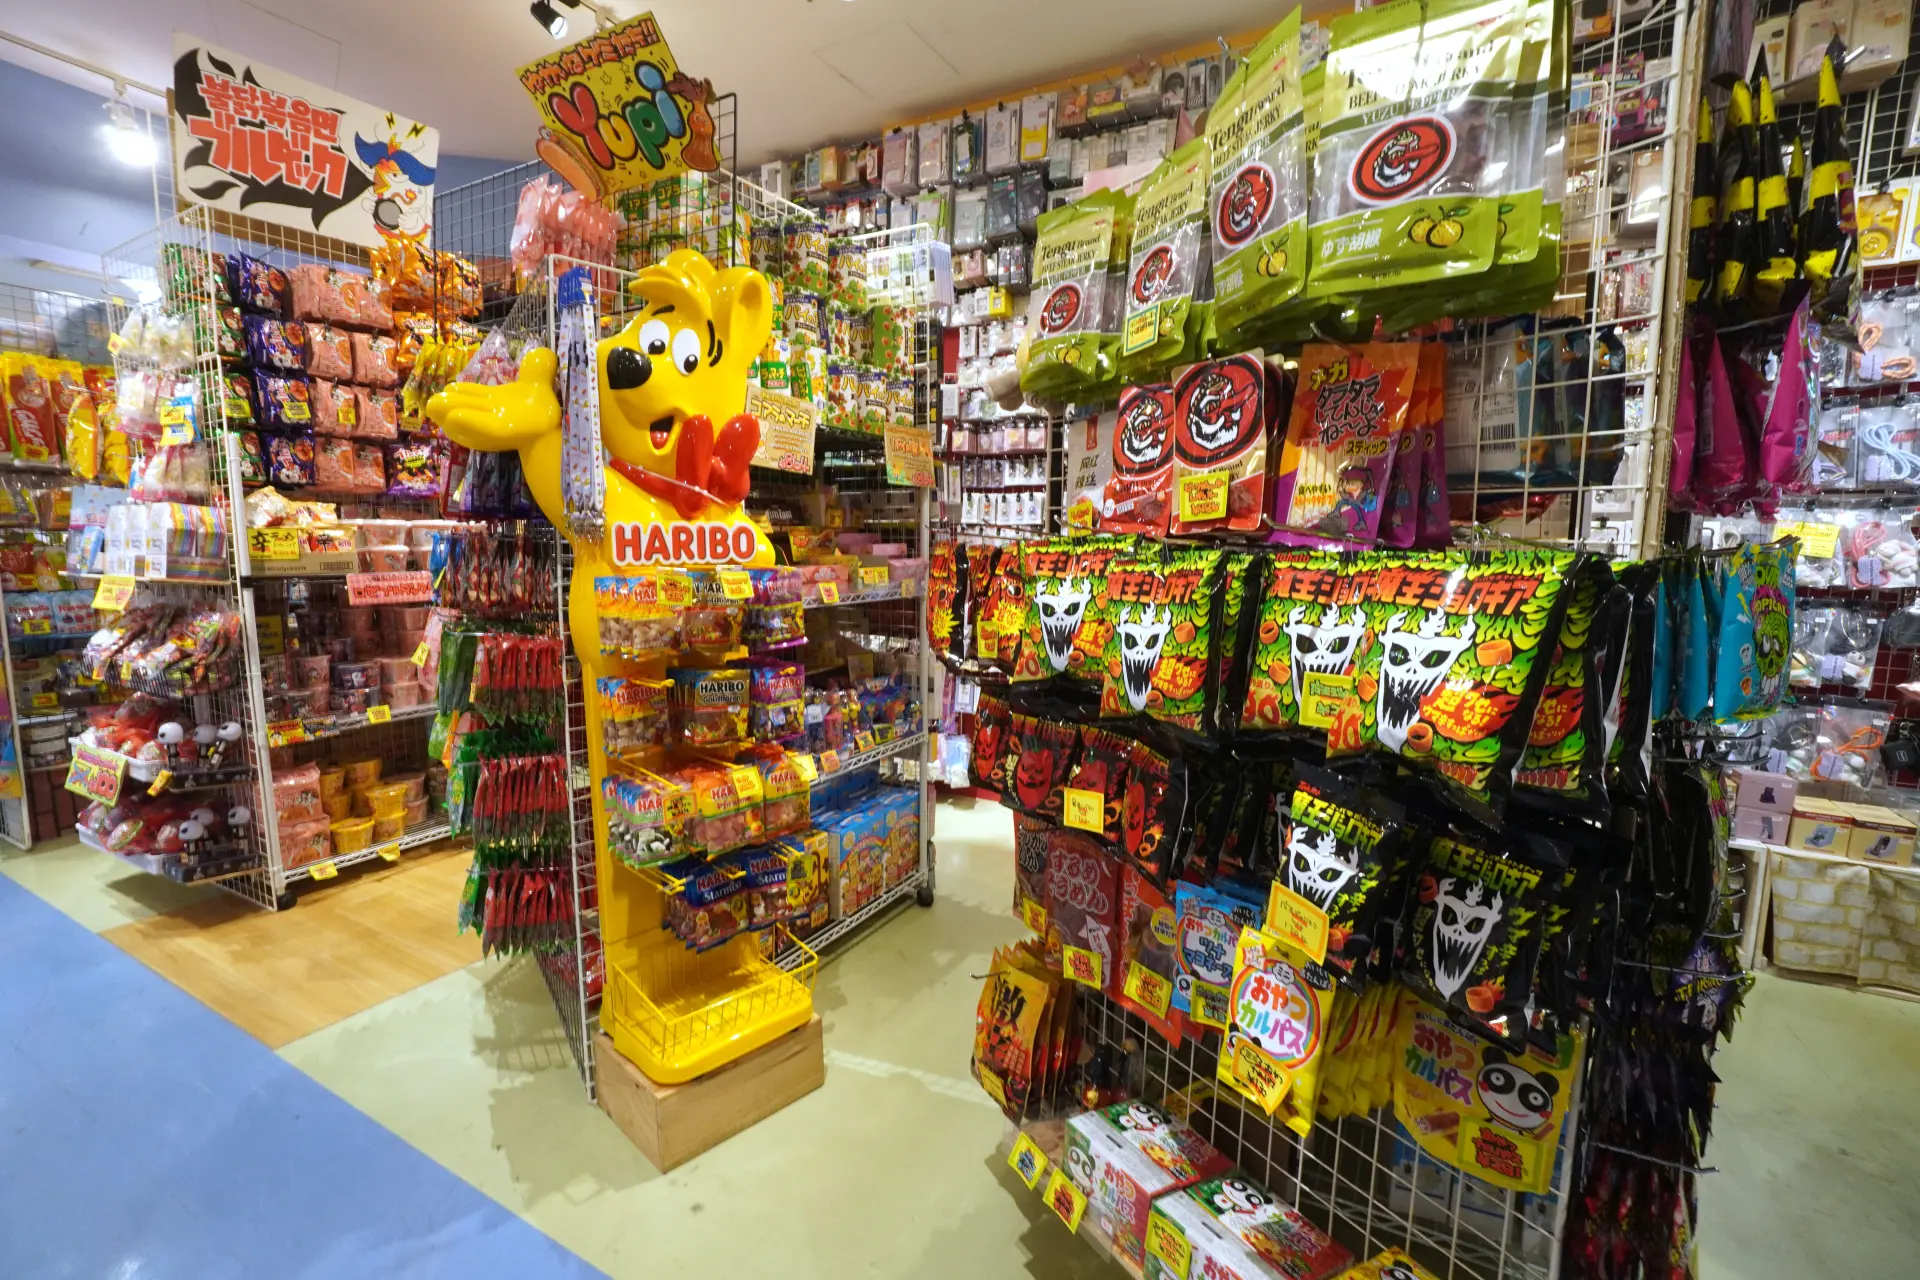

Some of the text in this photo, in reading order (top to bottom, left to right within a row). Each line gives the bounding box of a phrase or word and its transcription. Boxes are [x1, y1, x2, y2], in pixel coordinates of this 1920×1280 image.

[199, 72, 341, 146] 불닭볶음면
[548, 60, 687, 170] Yupi
[1210, 108, 1253, 150] Tengu
[1361, 107, 1399, 125] YUZU
[1042, 240, 1076, 259] Tengu
[1321, 228, 1382, 258] ゆず胡椒
[1345, 438, 1390, 455] スティック
[614, 523, 756, 563] HARIBO
[1025, 552, 1115, 578] 魔王ジョロキ
[1376, 566, 1541, 616] 魔王ジョロキア
[700, 679, 744, 693] HARIBO
[704, 879, 742, 901] Starmix
[1199, 936, 1227, 960] ツナ
[1276, 967, 1292, 981] ミニ
[1250, 974, 1308, 1022] おやつ
[1238, 999, 1305, 1058] カルパス
[1413, 1022, 1476, 1071] おやつ
[1405, 1045, 1474, 1106] カルパス
[1099, 1177, 1136, 1225] カルパス
[1103, 1161, 1136, 1201] おやつ
